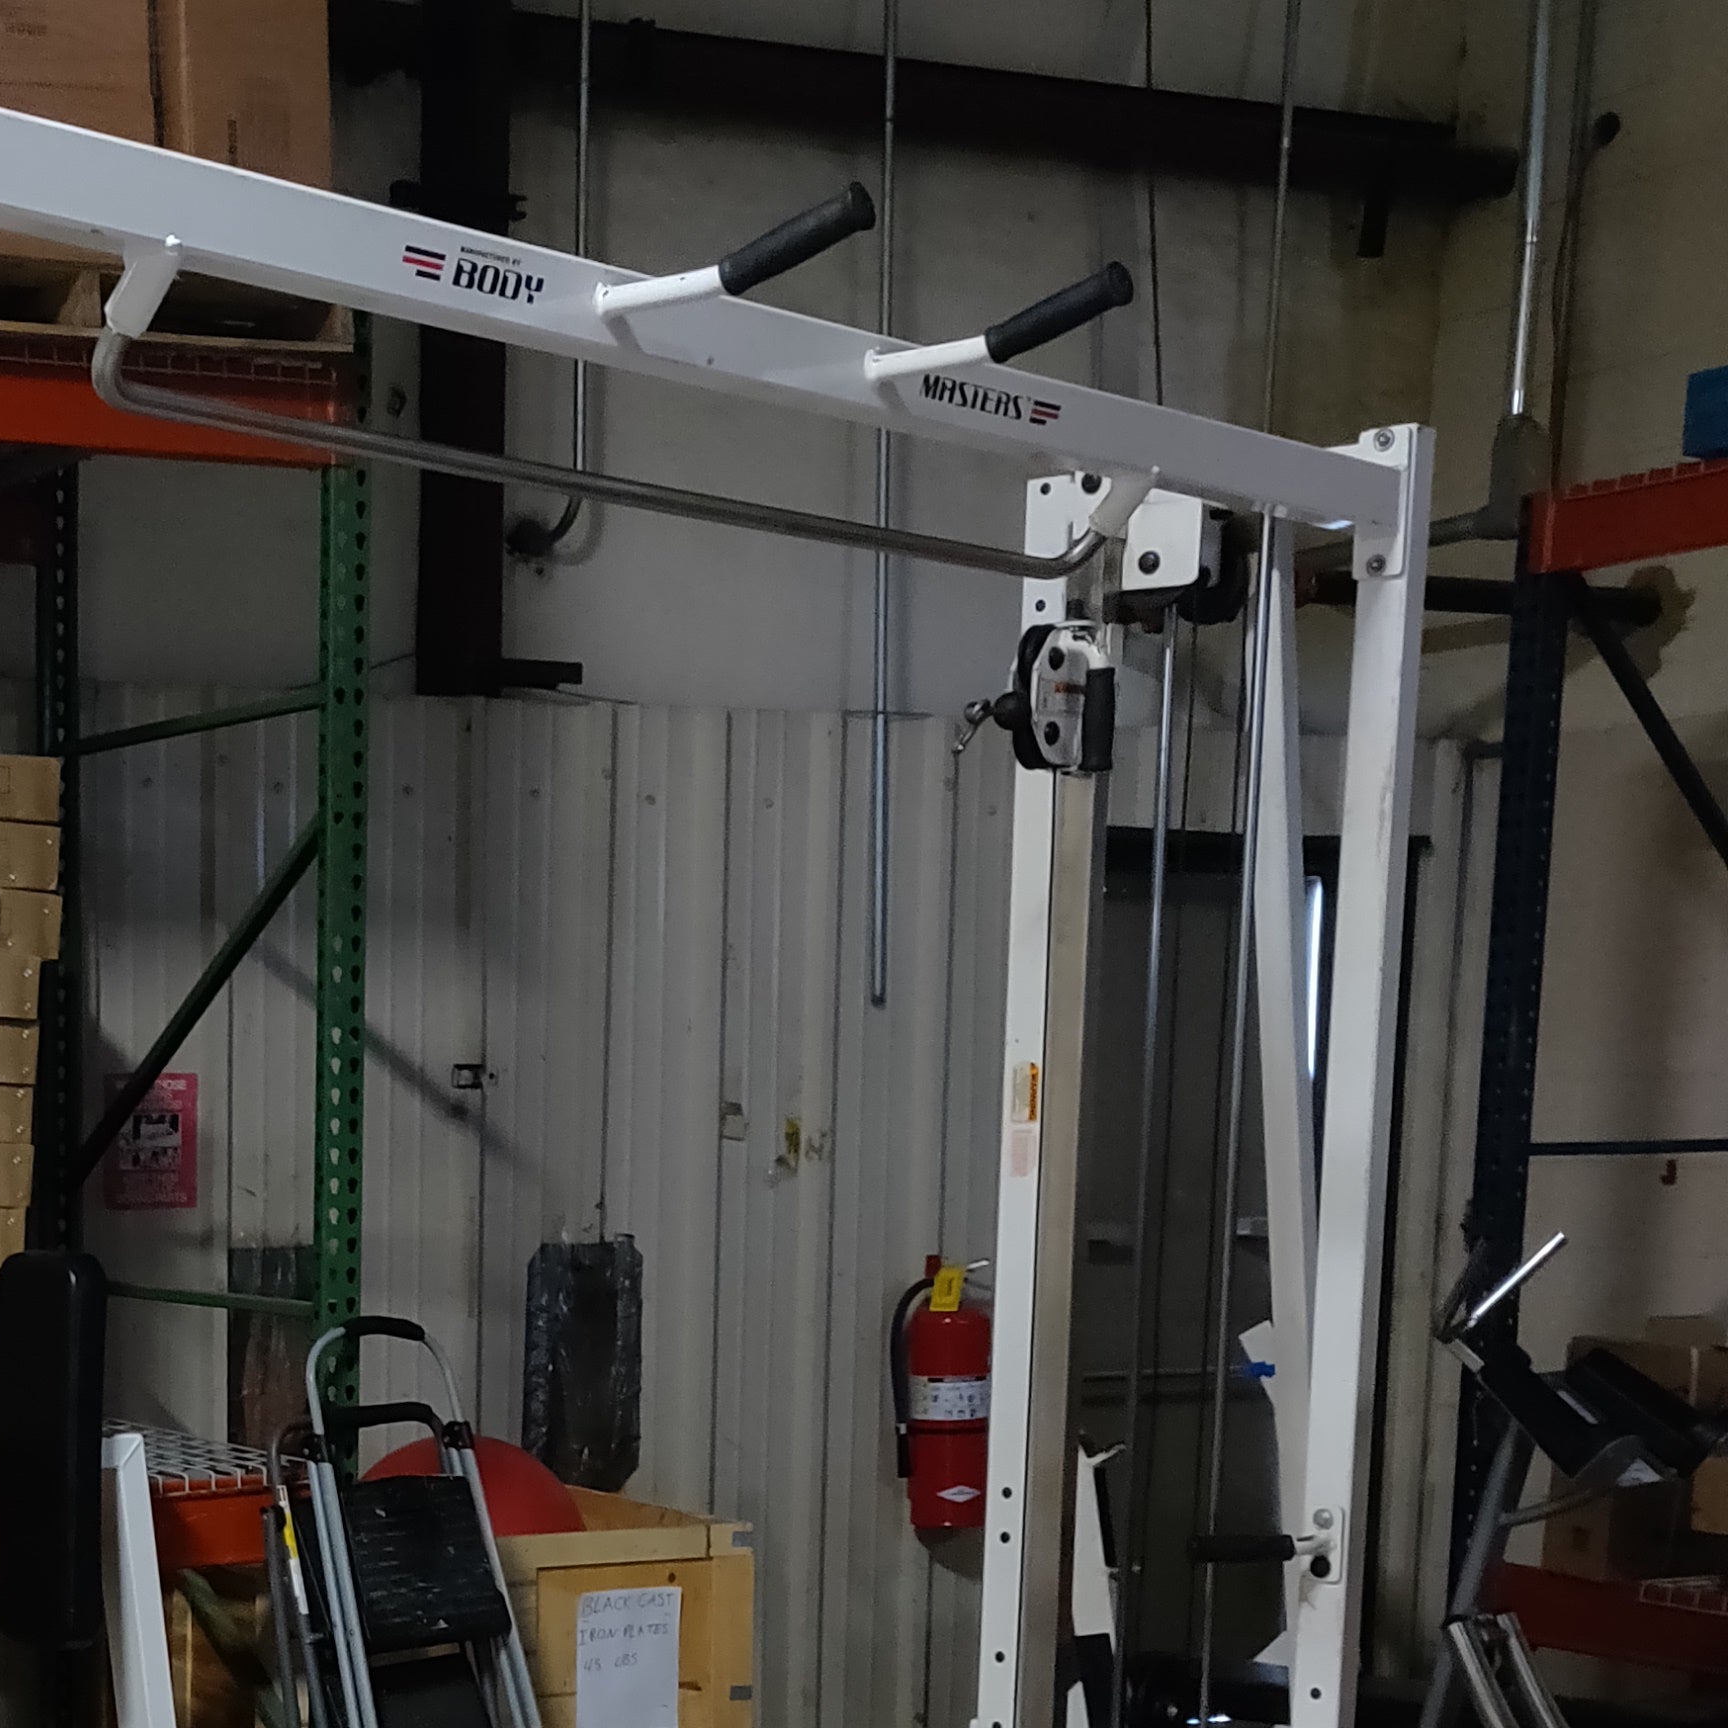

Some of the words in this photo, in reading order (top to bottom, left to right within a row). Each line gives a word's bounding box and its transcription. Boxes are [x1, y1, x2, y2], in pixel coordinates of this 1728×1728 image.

[452, 258, 544, 304] BODY
[919, 373, 1023, 420] MASTERS
[581, 1595, 630, 1618] BLACK
[638, 1592, 674, 1608] CAST
[578, 1627, 618, 1646] IRON
[623, 1622, 669, 1639] PLATES
